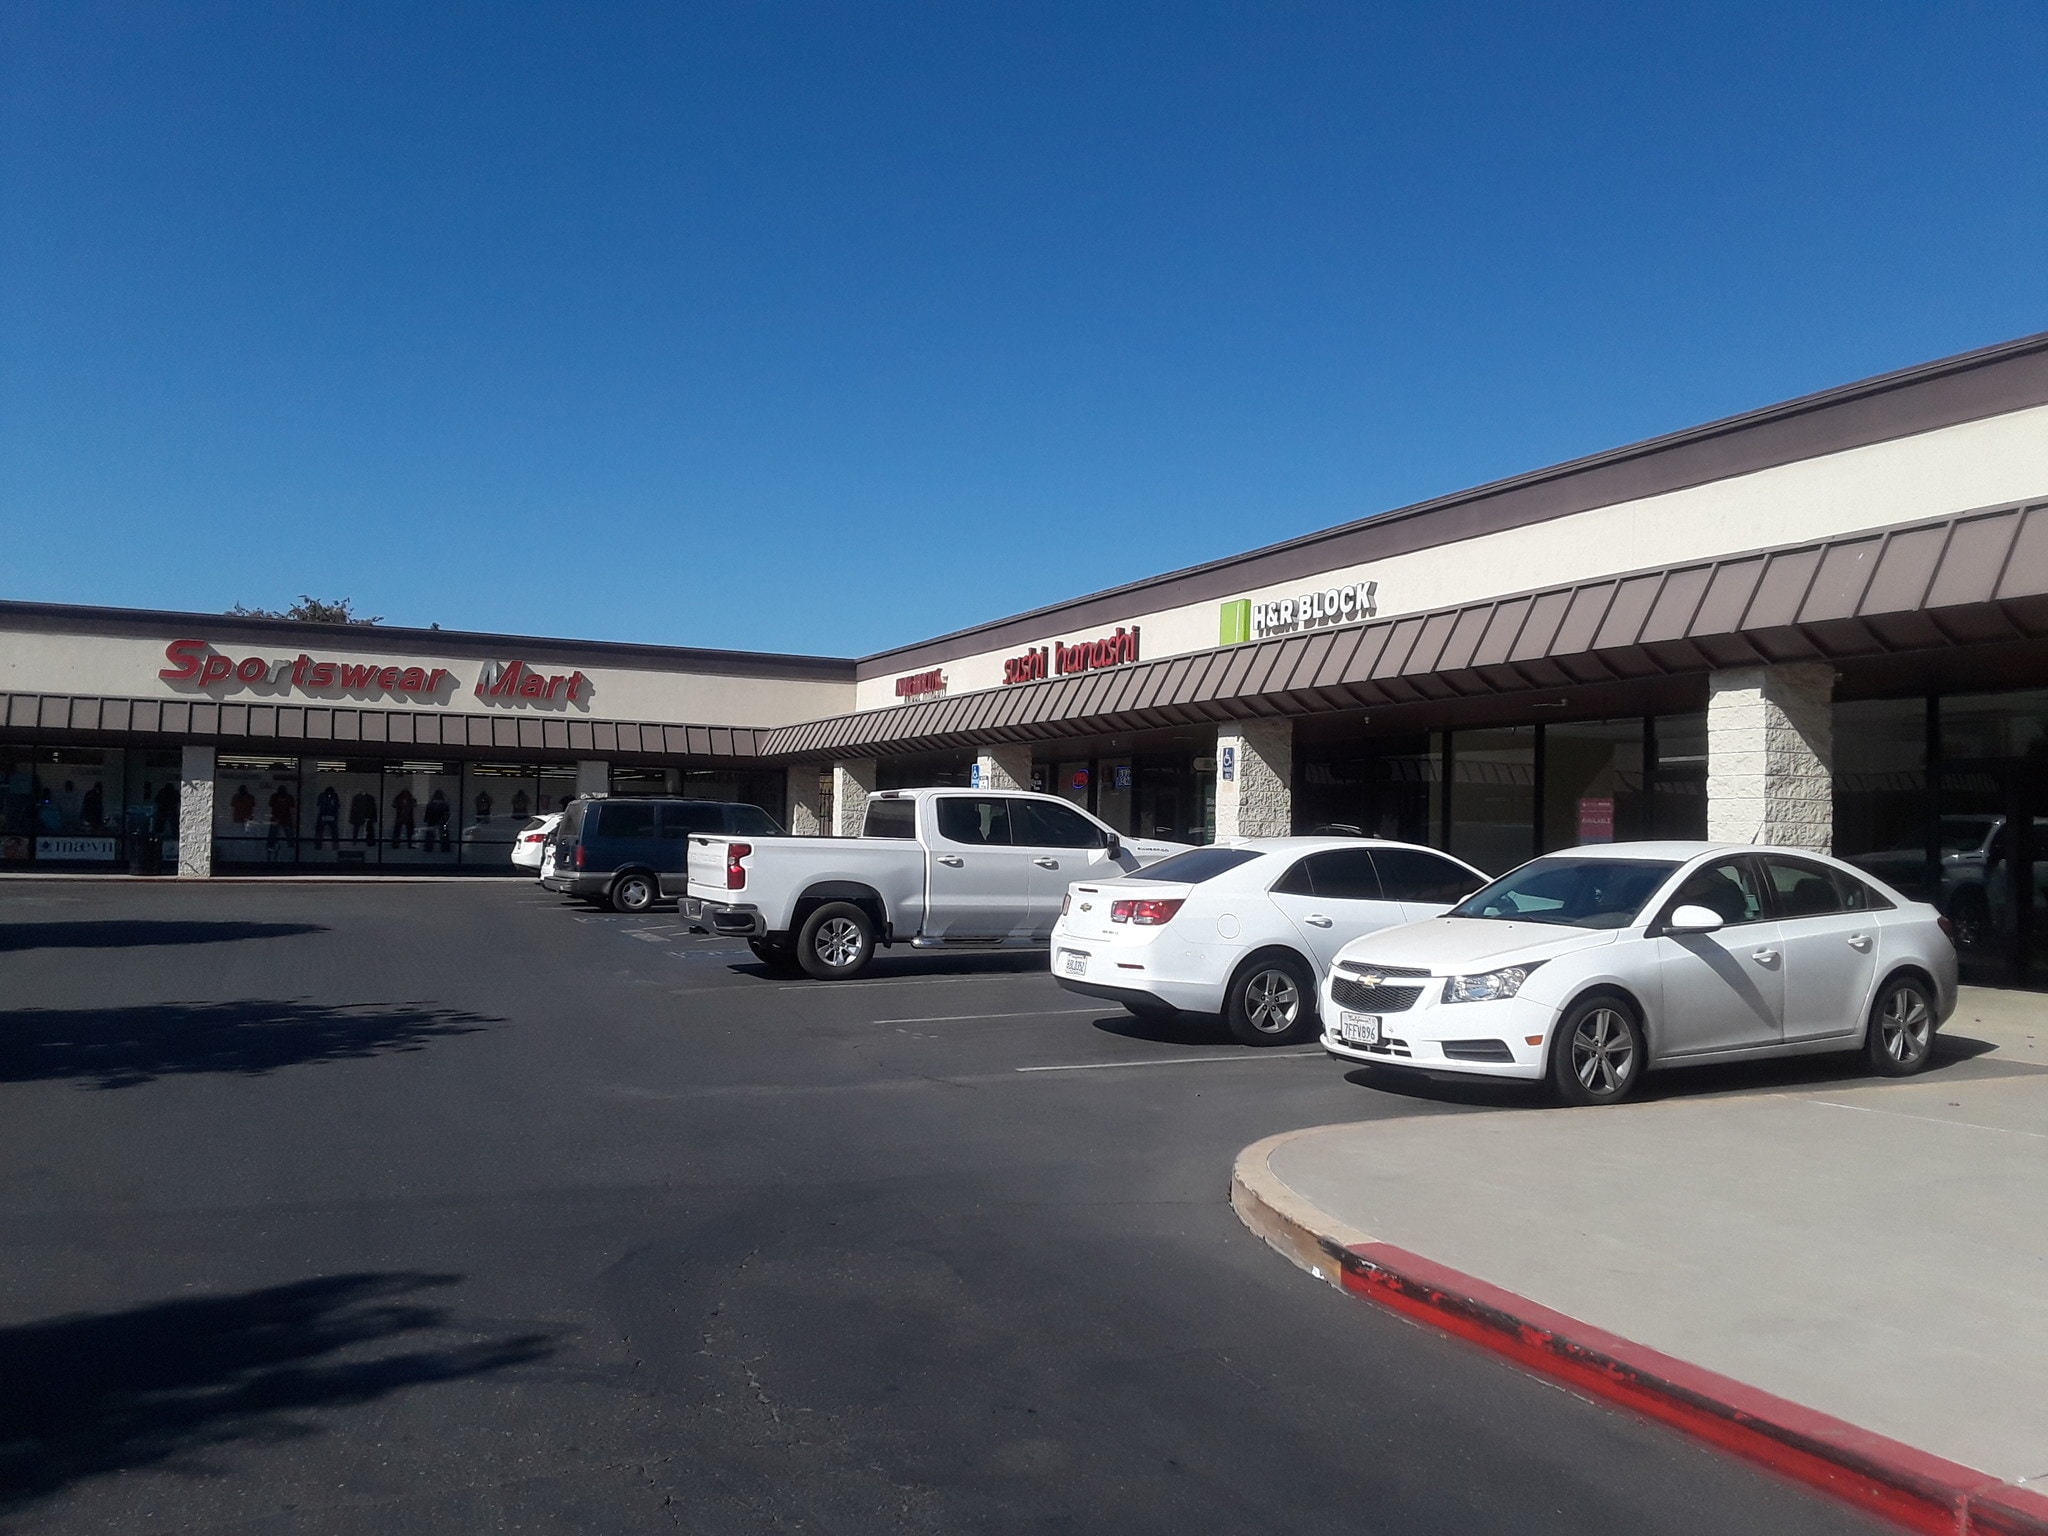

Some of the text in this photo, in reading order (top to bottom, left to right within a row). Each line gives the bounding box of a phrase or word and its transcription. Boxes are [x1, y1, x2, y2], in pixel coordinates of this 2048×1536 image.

[1254, 581, 1374, 631] H&R BLOCK
[158, 639, 584, 700] Sportswear Mart
[1003, 626, 1140, 684] sushi hanashi
[1343, 1022, 1376, 1040] 7FFV896
